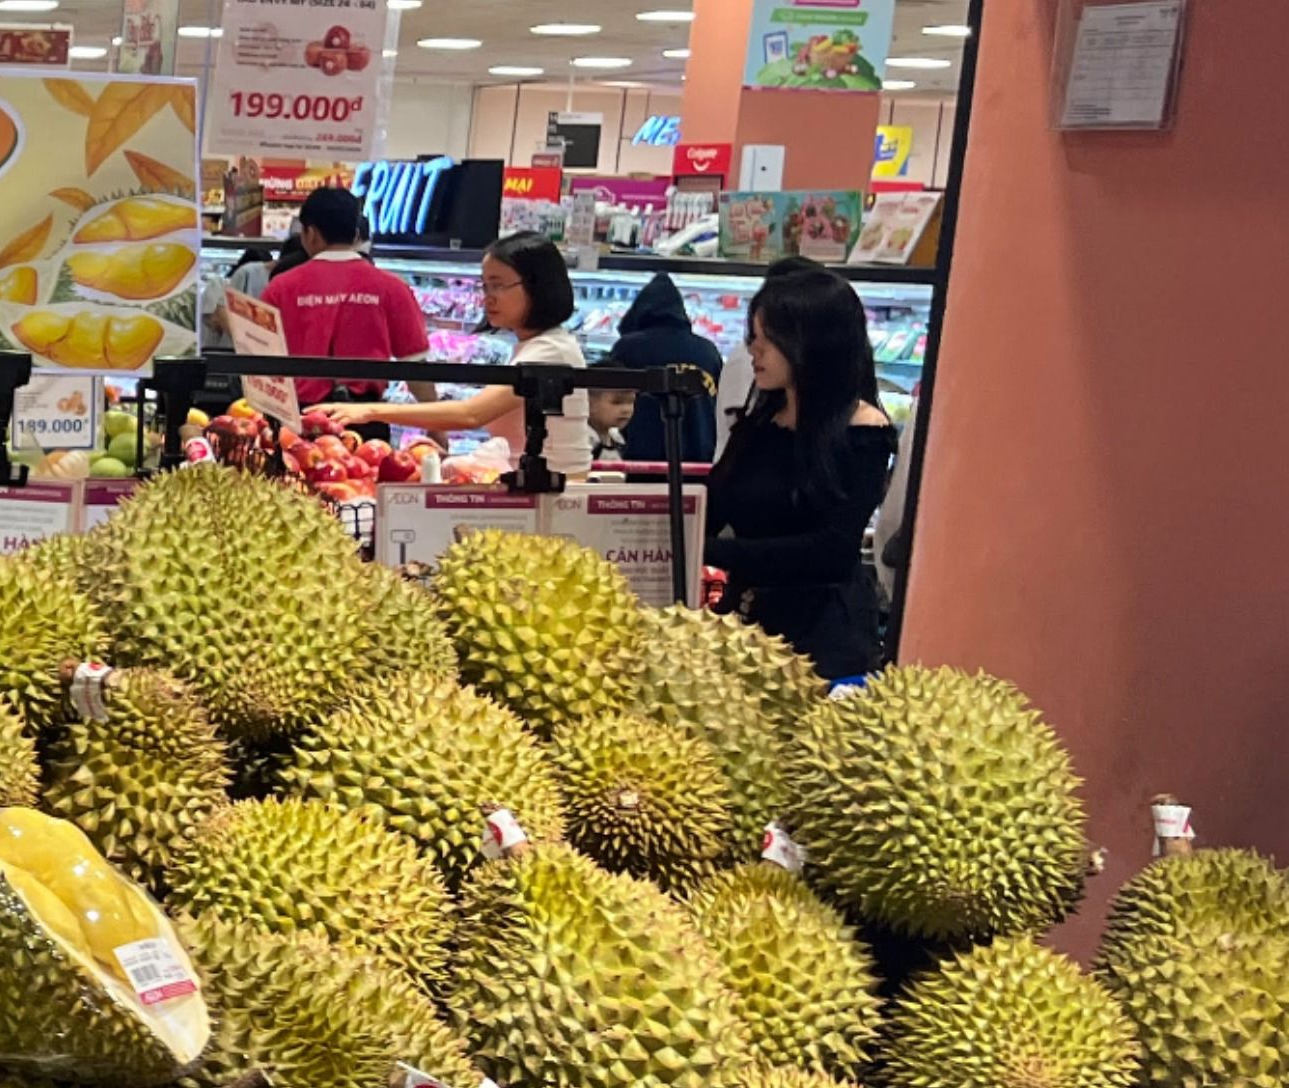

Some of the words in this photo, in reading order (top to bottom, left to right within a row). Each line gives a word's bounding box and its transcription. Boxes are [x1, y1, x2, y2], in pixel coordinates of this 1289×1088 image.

[348, 292, 379, 305] AEON
[470, 494, 485, 504] TIN
[643, 548, 671, 562] HÀN
